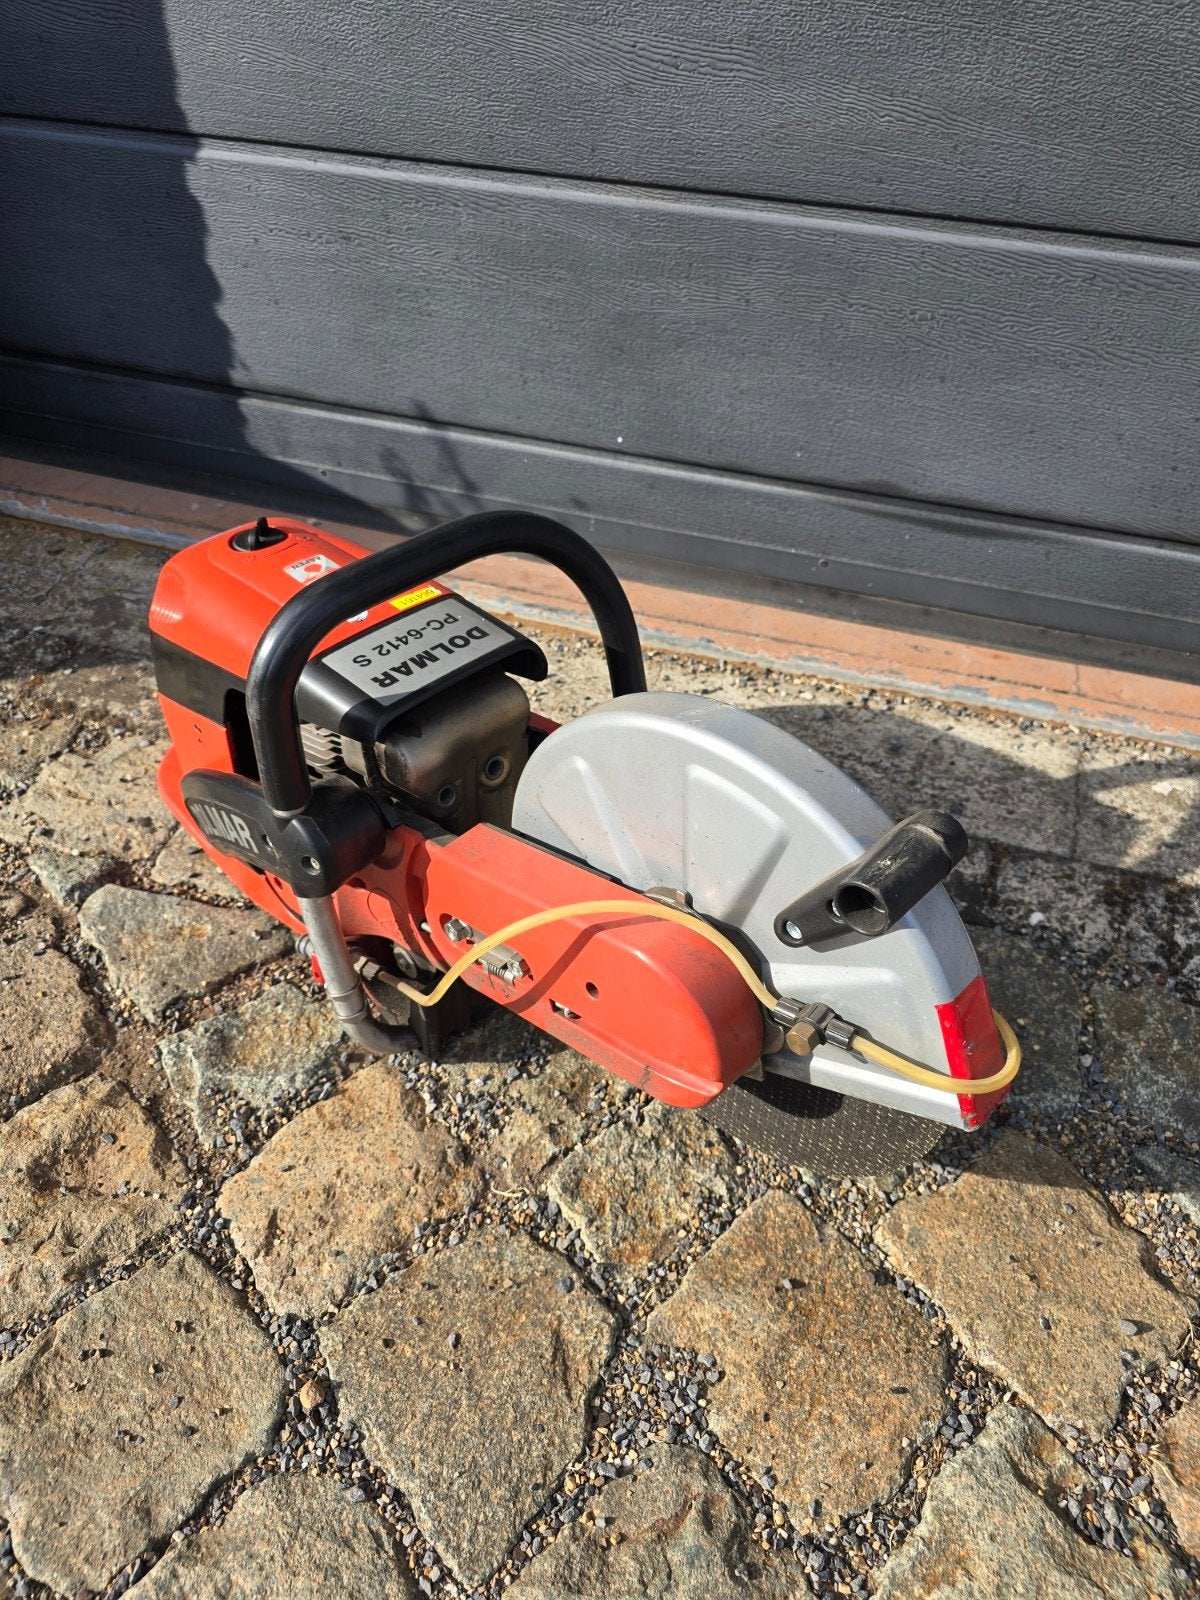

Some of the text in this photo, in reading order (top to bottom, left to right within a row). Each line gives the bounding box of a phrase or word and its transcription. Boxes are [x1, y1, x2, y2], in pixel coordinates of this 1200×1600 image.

[290, 555, 321, 570] ASPEN
[352, 613, 460, 667] PC-6412 S
[371, 626, 490, 688] DOLMAR
